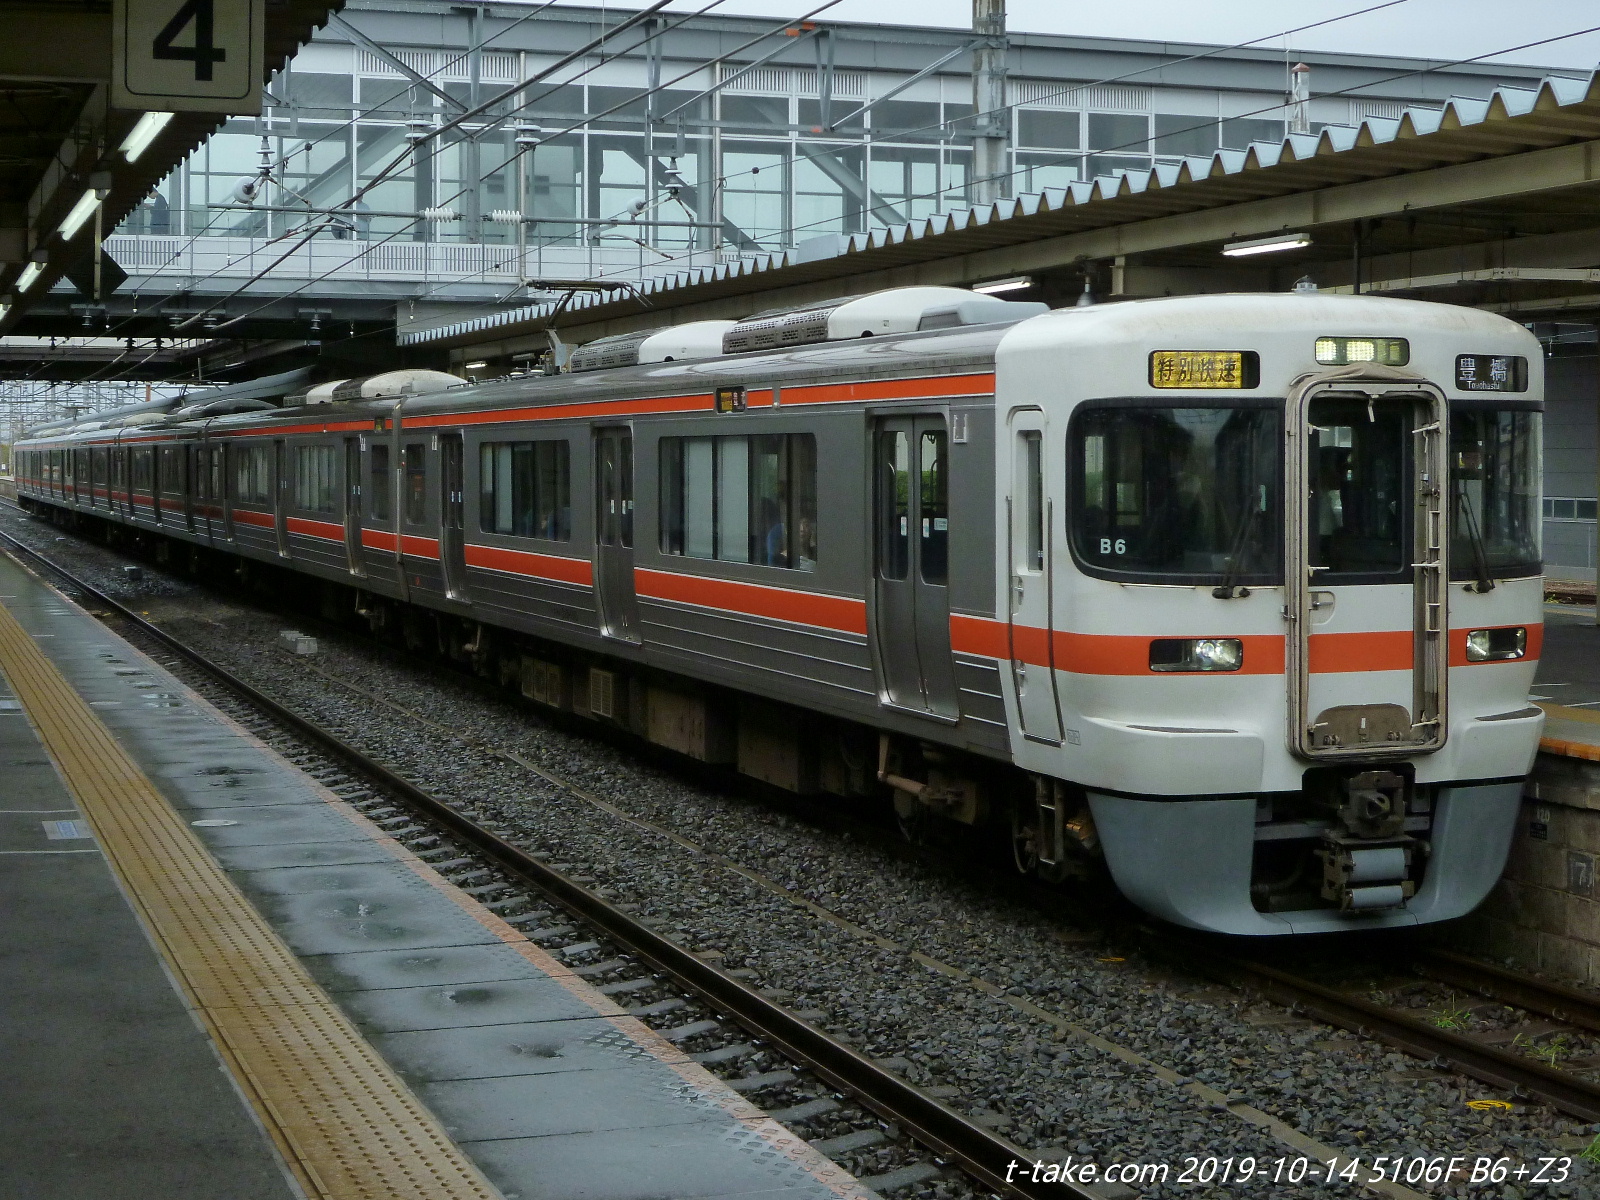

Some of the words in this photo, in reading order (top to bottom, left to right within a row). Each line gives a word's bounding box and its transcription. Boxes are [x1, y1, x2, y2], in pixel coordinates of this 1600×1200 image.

[152, 0, 226, 81] 4
[1157, 357, 1237, 382] 特別快速
[1459, 358, 1507, 382] 豊橋
[1100, 538, 1126, 555] B6
